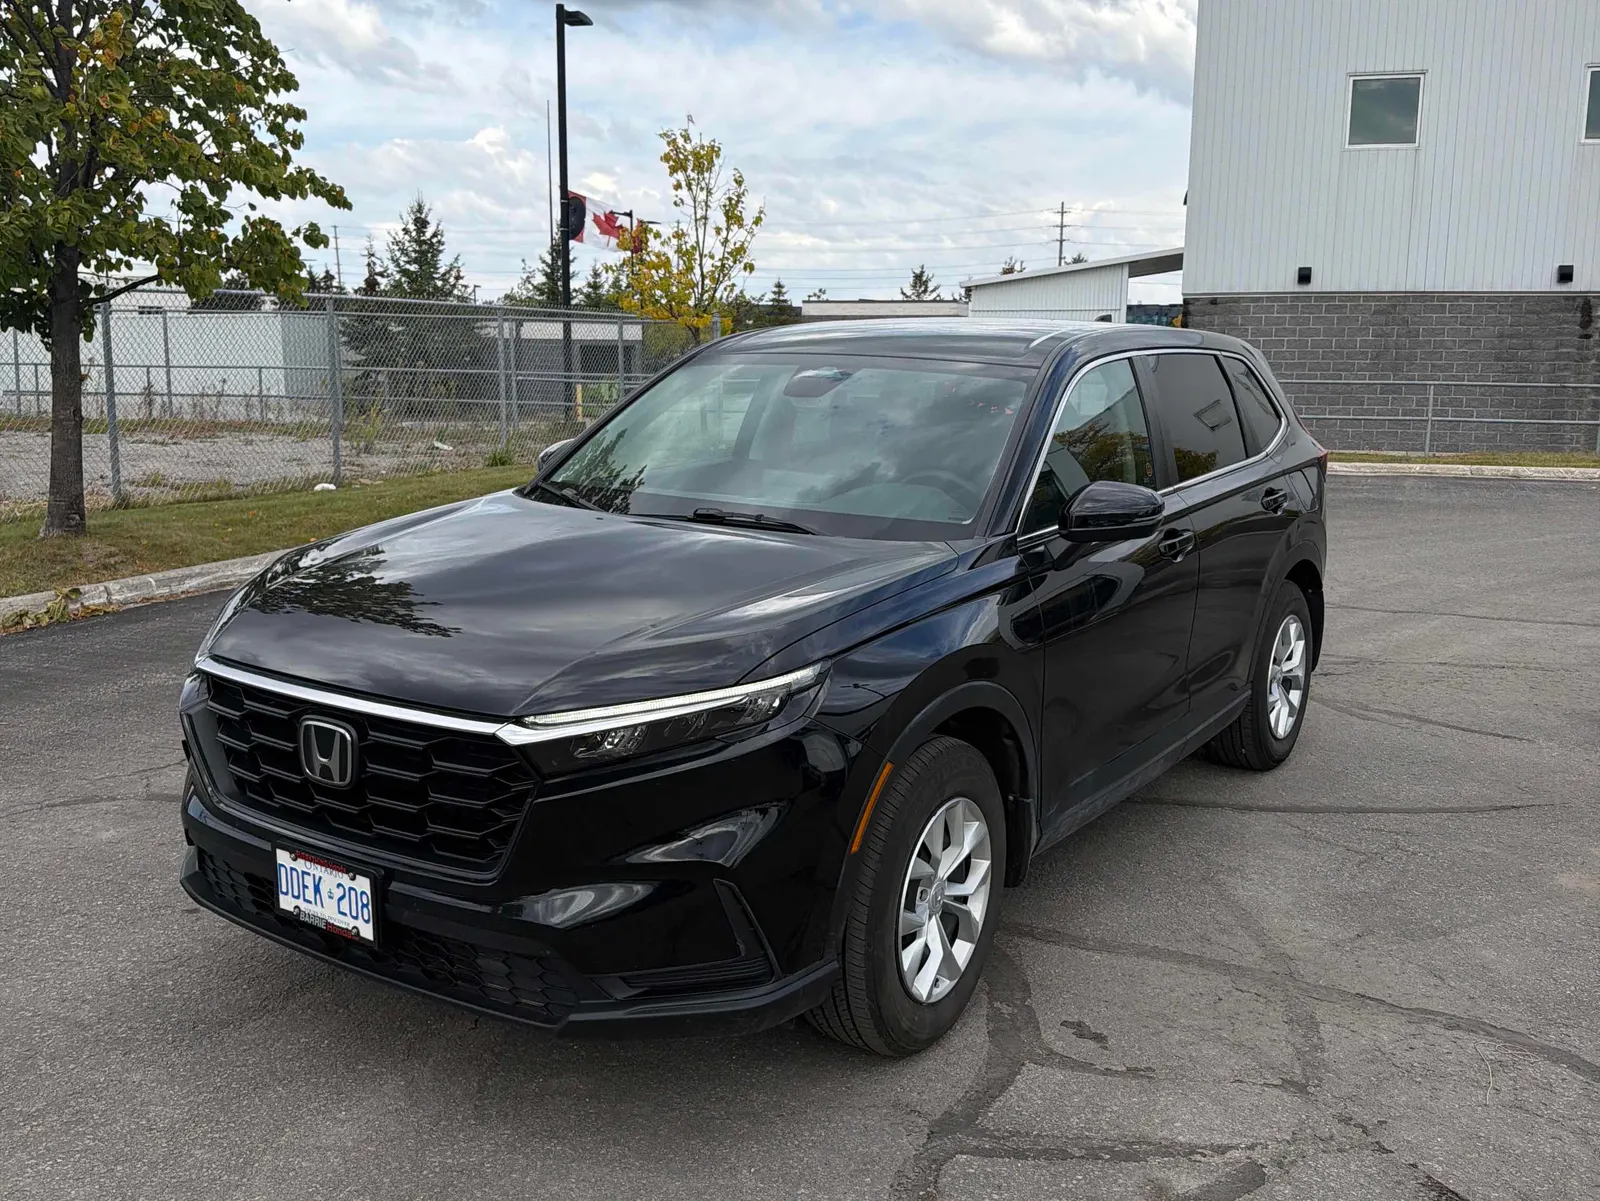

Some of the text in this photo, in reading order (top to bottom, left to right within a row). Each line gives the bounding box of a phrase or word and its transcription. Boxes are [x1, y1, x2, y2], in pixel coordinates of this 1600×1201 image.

[278, 863, 371, 924] DDEK 208
[300, 911, 327, 930] BARRIE
